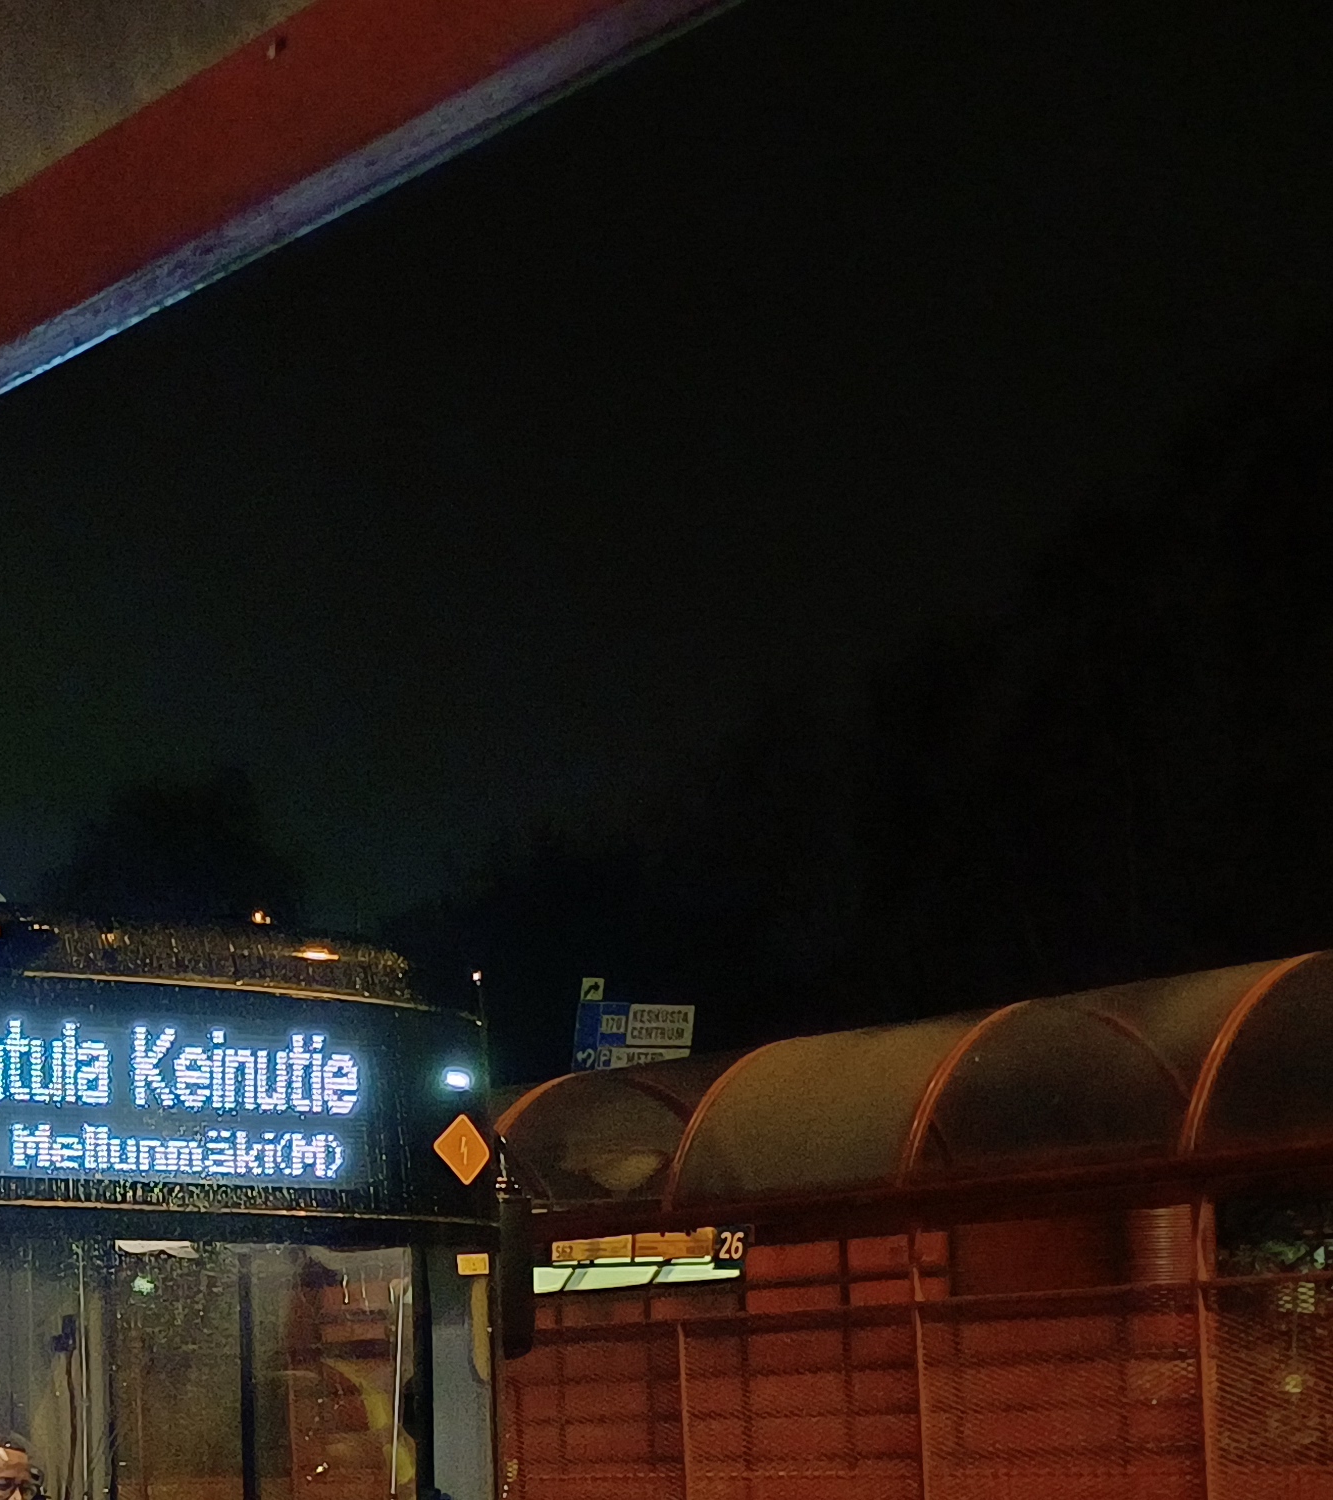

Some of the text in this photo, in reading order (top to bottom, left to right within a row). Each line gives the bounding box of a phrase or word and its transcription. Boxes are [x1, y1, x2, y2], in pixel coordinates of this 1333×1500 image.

[632, 1008, 690, 1025] KESKUSTA
[630, 1026, 686, 1041] CENTRUM
[129, 1025, 361, 1117] Keinutie
[718, 1231, 745, 1260] 26
